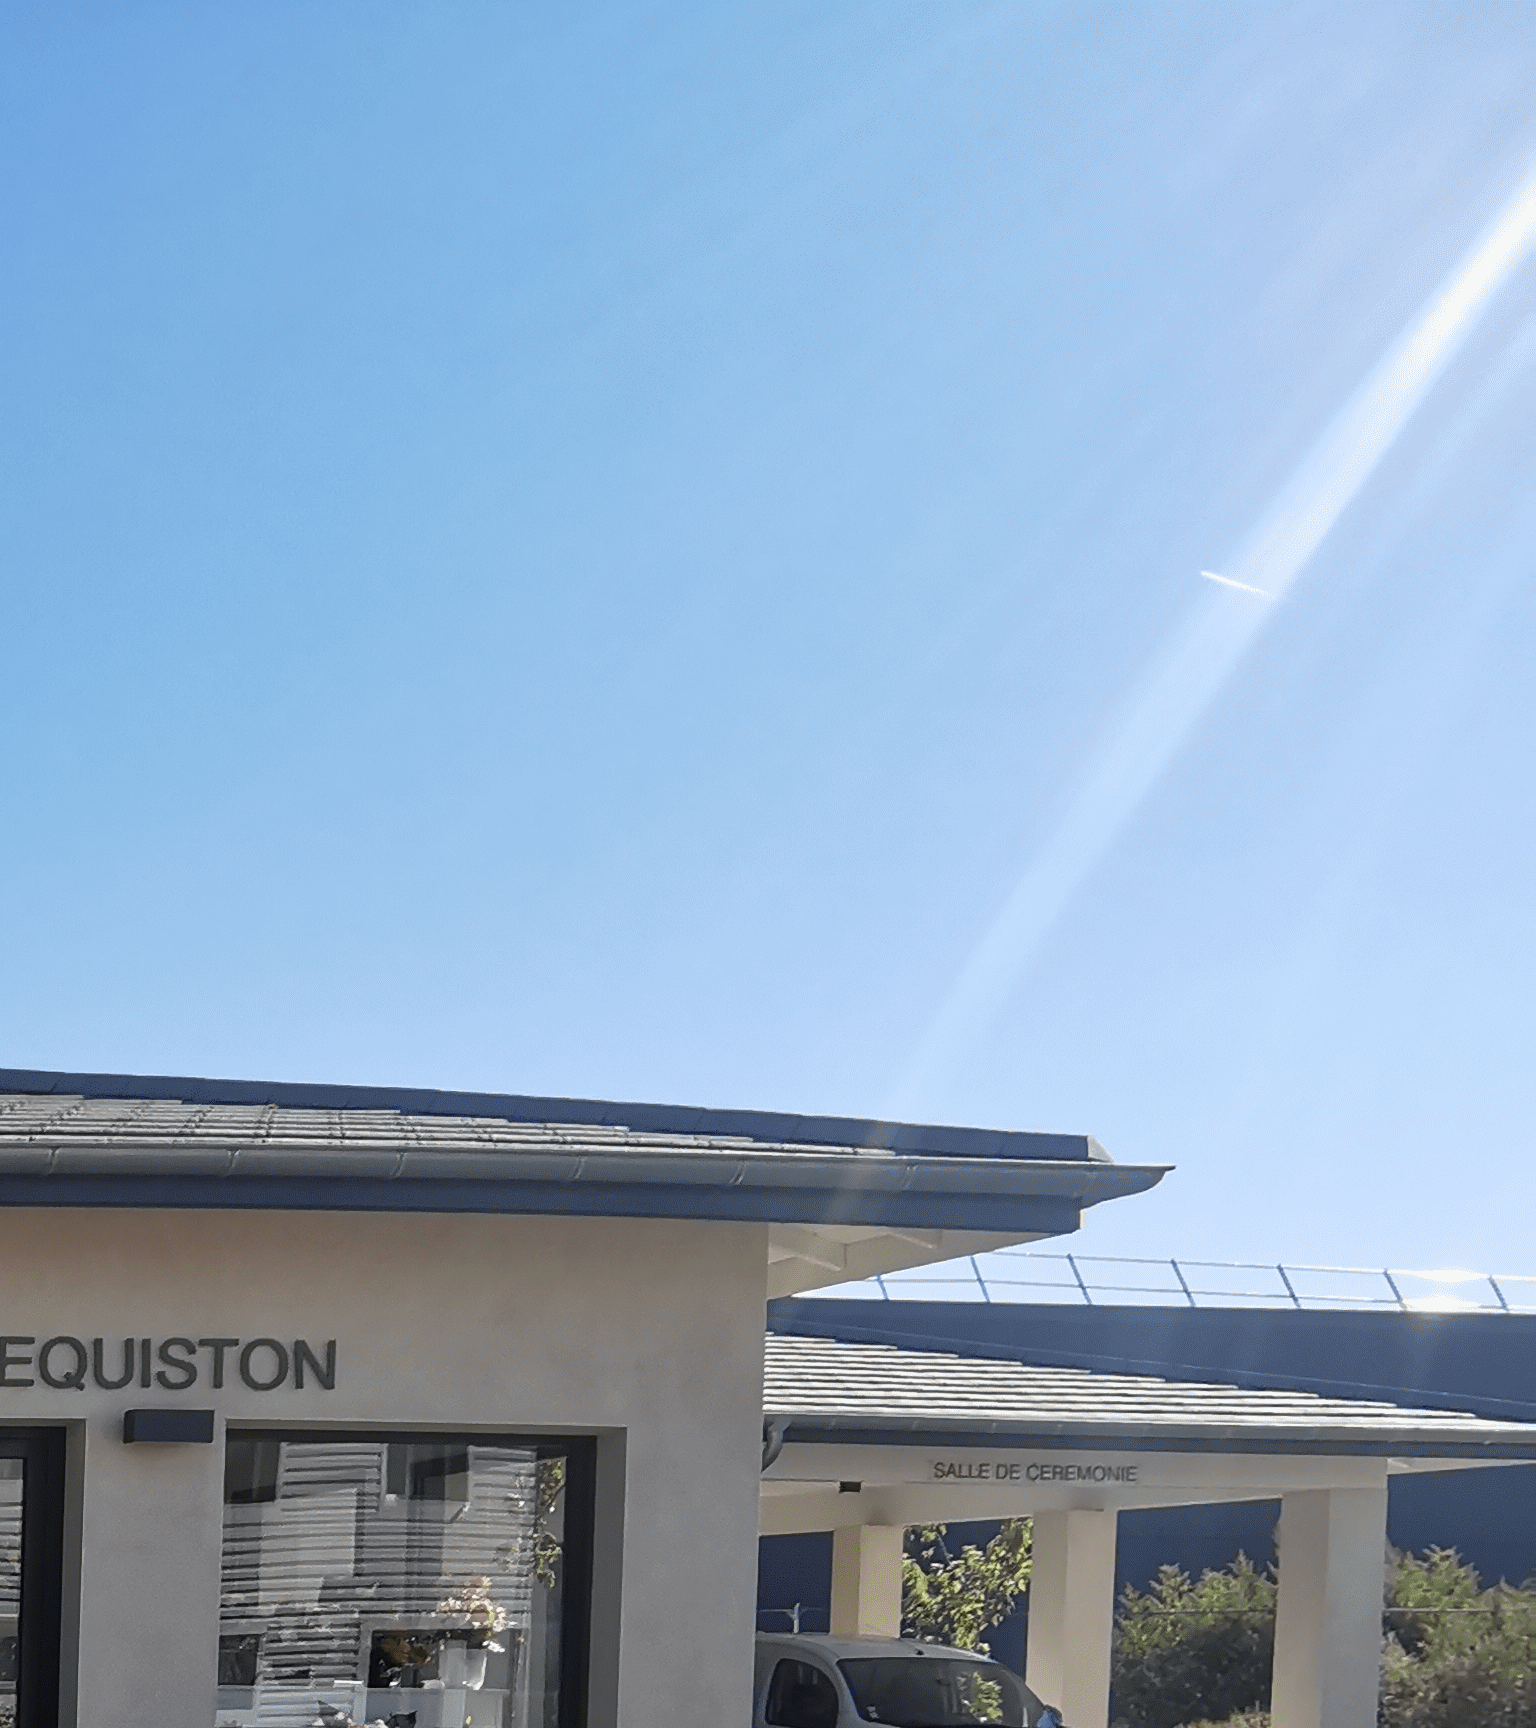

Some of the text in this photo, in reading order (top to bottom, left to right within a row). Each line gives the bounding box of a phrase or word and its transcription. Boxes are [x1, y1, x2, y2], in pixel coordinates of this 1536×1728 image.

[933, 1462, 1138, 1484] SALLE DE CEREMONIE
